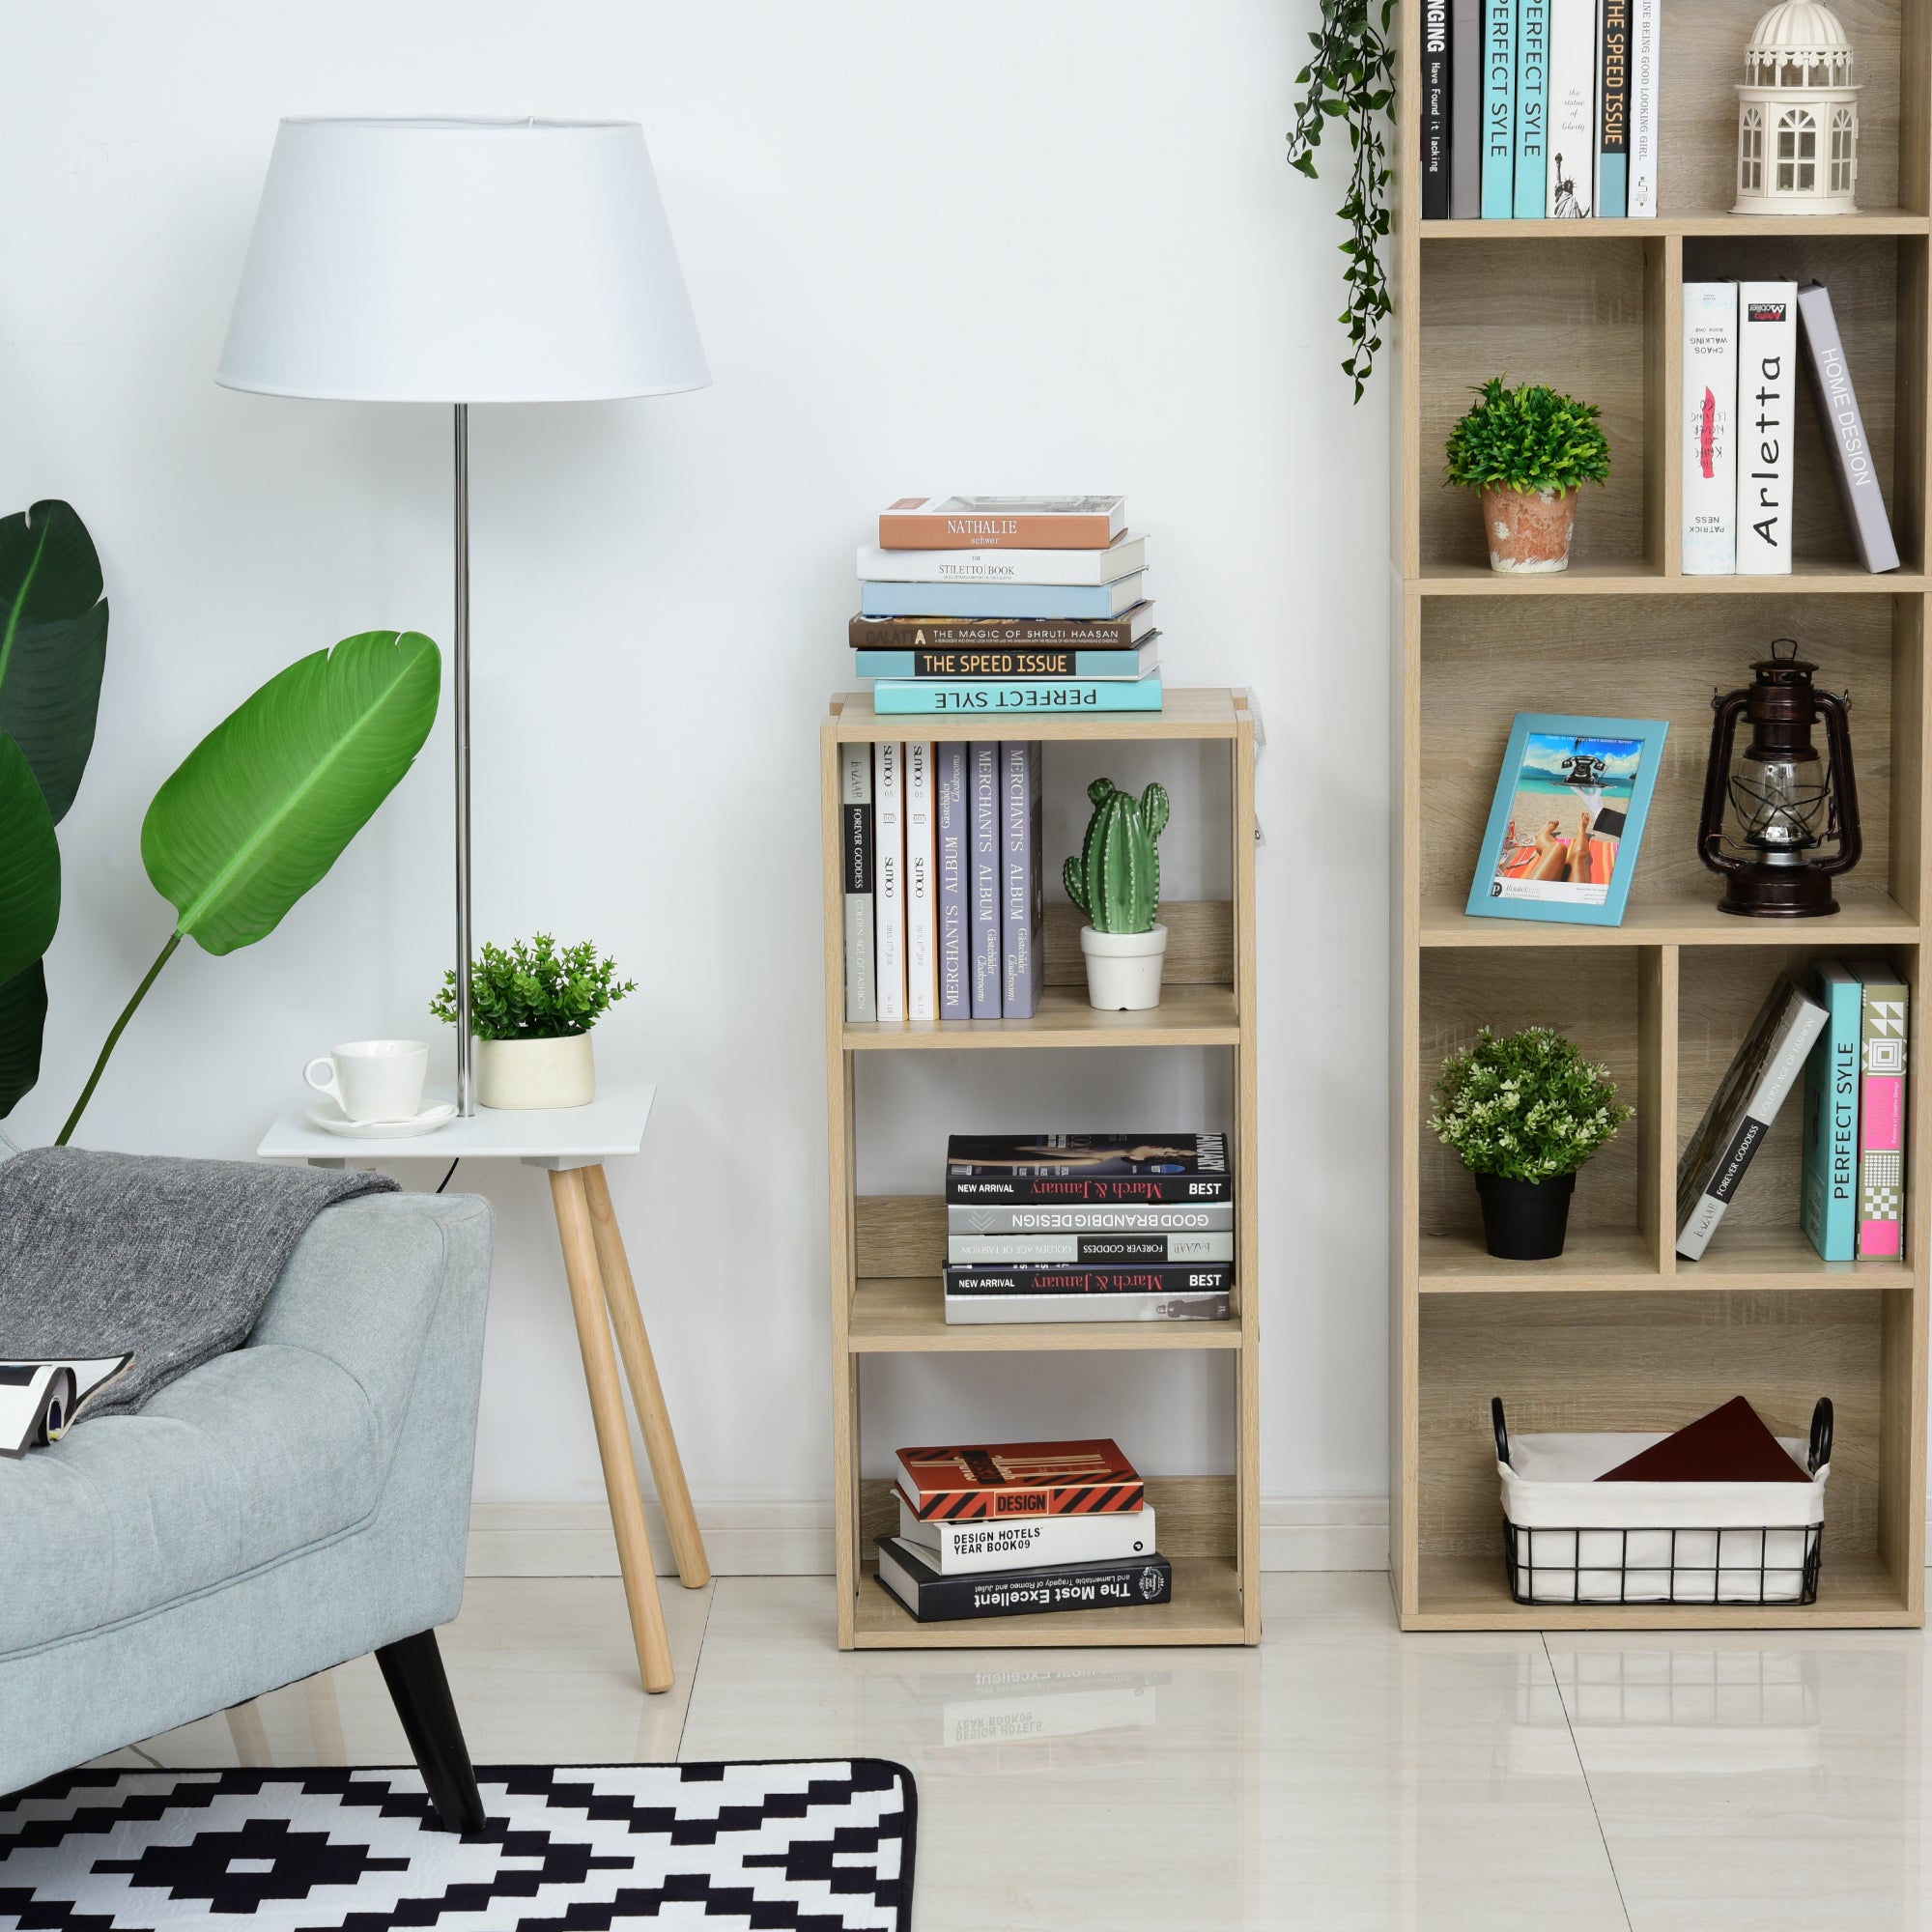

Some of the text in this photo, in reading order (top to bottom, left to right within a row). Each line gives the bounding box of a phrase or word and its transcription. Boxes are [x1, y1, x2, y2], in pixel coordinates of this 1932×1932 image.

[1641, 21, 1650, 53] BEING
[1605, 34, 1624, 87] SPEED
[1641, 56, 1650, 85] GOOD
[1430, 63, 1440, 172] Have Found it lacking
[1605, 93, 1622, 144] ISSUE
[1639, 88, 1649, 132] LOOKING
[1491, 102, 1507, 157] SYLE
[1524, 102, 1541, 157] SYLE
[1638, 136, 1648, 160] GIRL
[1822, 348, 1870, 486] HOME DESIGN
[1750, 356, 1779, 547] Arletta
[948, 520, 1018, 534] NATHALIE
[971, 536, 1000, 545] schwer
[939, 564, 1014, 575] STILETTO BOOK
[923, 656, 1067, 672] THE SPEED ISSUE
[934, 689, 1096, 708] PERFECT SYLE
[952, 754, 961, 802] Cloakrooms
[979, 750, 993, 922] MERCHANTS ALBUM
[1010, 750, 1024, 920] MERCHANTS ALBUM
[854, 847, 864, 889] GODDESS
[945, 837, 959, 1007] MERCHANTS ALBUM
[856, 900, 866, 1009] GOLDEN AGE OF FASHION
[977, 955, 987, 1003] Cloakrooms
[1007, 954, 1017, 1001] Cloakrooms
[1759, 1017, 1816, 1117] GOLDEN AGE OF FASHION
[1833, 1043, 1854, 1199] PERFECT SYLE
[1717, 1124, 1759, 1197] FOREVER GODDESS
[979, 1184, 1014, 1193] ARRIVAL
[1031, 1179, 1163, 1199] March & January
[1188, 1183, 1222, 1196] BEST
[1012, 1213, 1209, 1227] GOOD BRANDBIG DESIGN
[1036, 1245, 1072, 1254] GOLDEN
[1083, 1244, 1163, 1254] FOREVER GODDESS
[958, 1279, 1015, 1289] NEW ARRIVAL
[1032, 1271, 1163, 1291] March & January
[1189, 1274, 1223, 1287] BEST
[997, 1494, 1046, 1513] DESIGN
[954, 1532, 994, 1545] DESIGN
[954, 1540, 1031, 1554] YEAR BOOK09
[975, 1584, 993, 1593] Juliet
[995, 1583, 1008, 1592] and
[1009, 1581, 1036, 1590] Romeo
[1045, 1578, 1073, 1588] Tragedy
[1075, 1576, 1116, 1585] Lamentable
[974, 1581, 1131, 1608] The Most Excellent
